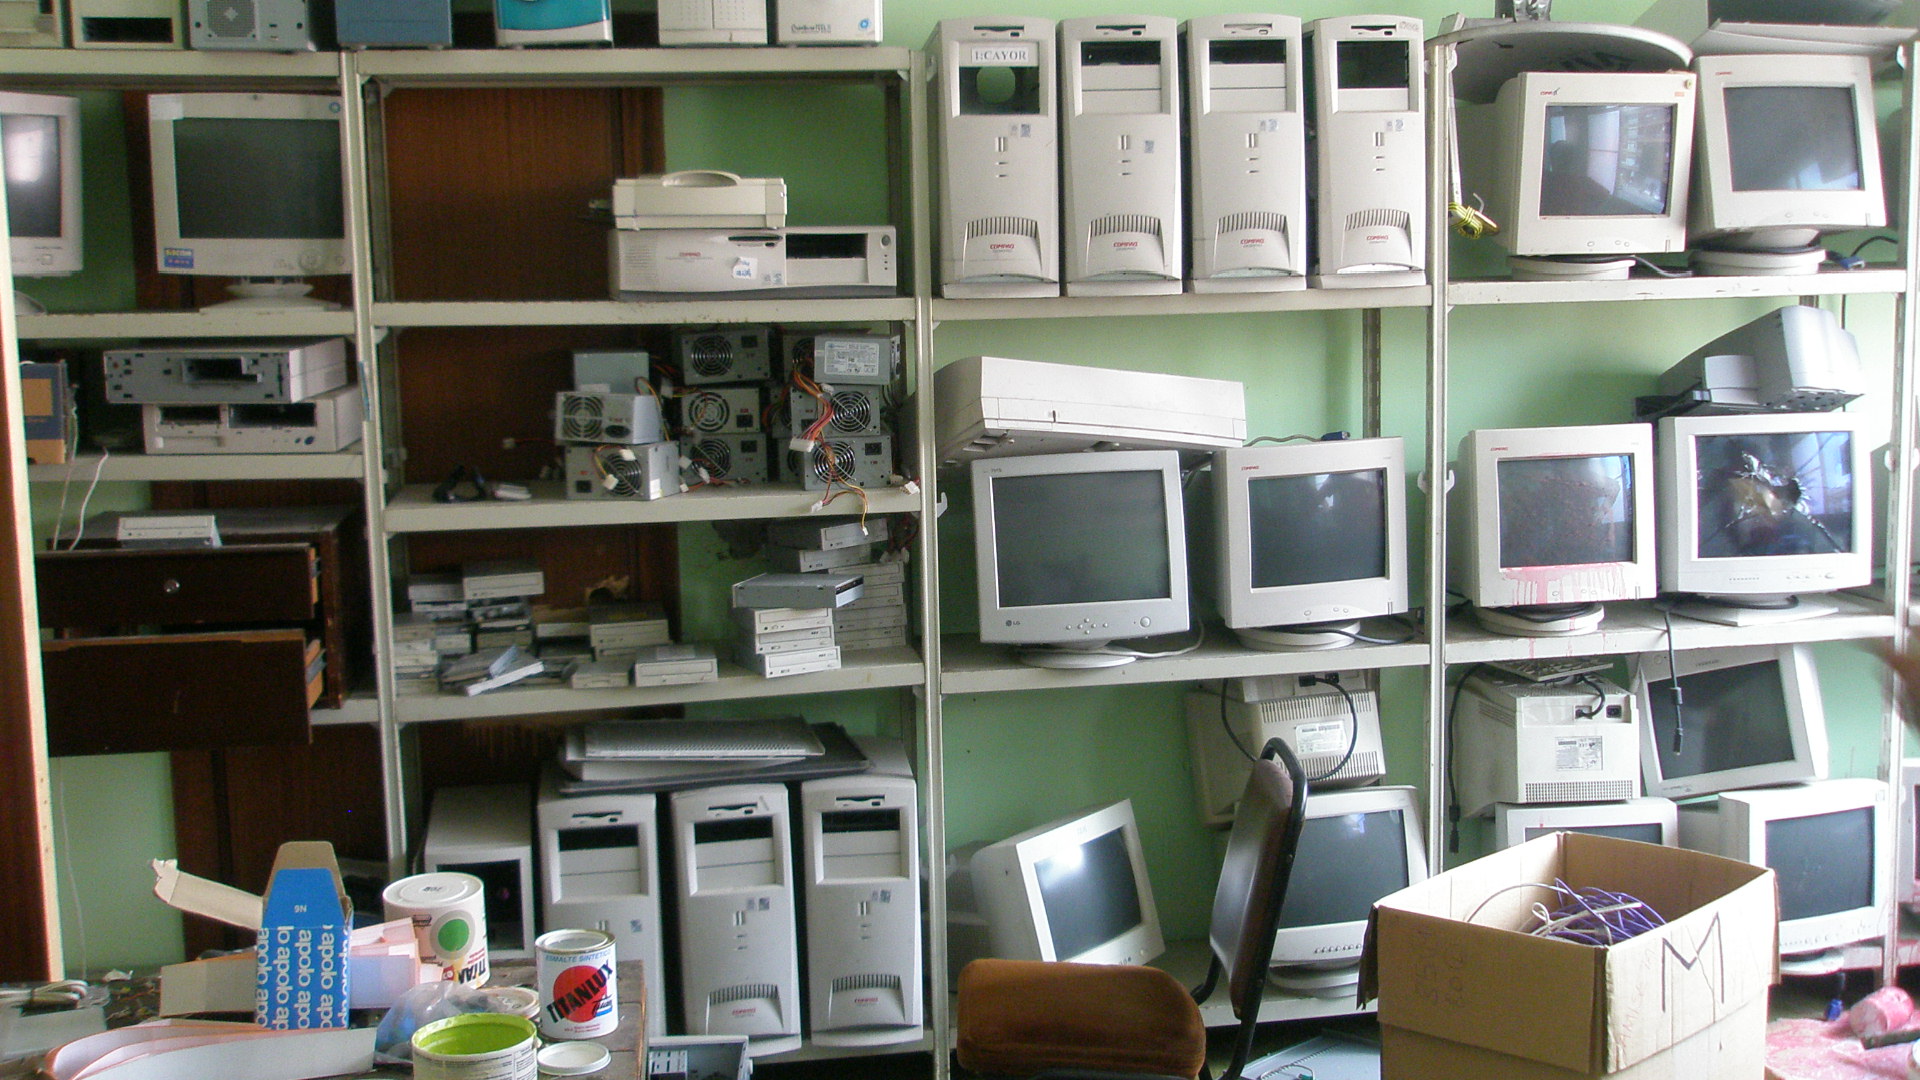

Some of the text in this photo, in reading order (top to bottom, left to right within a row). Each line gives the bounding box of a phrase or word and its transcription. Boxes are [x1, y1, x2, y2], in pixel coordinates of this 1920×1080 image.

[256, 927, 273, 985] apolo
[273, 946, 294, 1005] apolo
[294, 929, 316, 987] apolo
[317, 932, 338, 990] apolo
[546, 959, 613, 1024] TITANLUX
